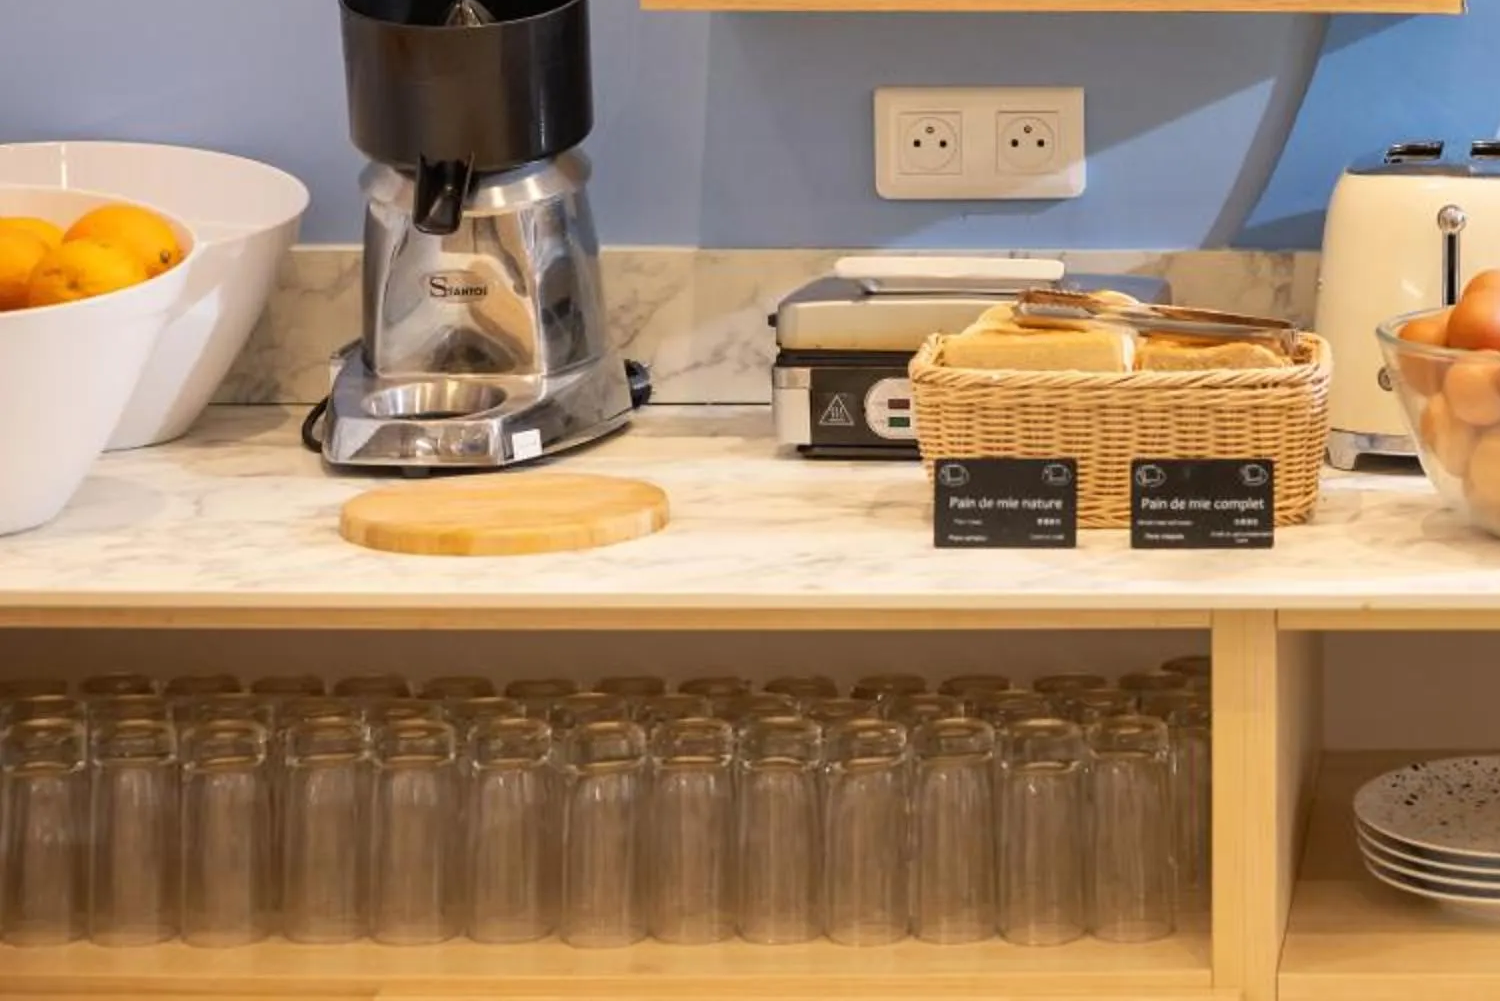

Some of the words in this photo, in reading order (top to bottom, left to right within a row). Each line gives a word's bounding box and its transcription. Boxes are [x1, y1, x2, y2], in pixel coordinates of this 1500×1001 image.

[949, 496, 976, 510] Pain
[978, 496, 995, 510] de
[997, 496, 1020, 510] mie
[1022, 497, 1063, 510] nature
[1141, 497, 1168, 510] Pain
[1170, 497, 1186, 510] de
[1188, 497, 1212, 510] mie
[1213, 497, 1265, 512] complet
